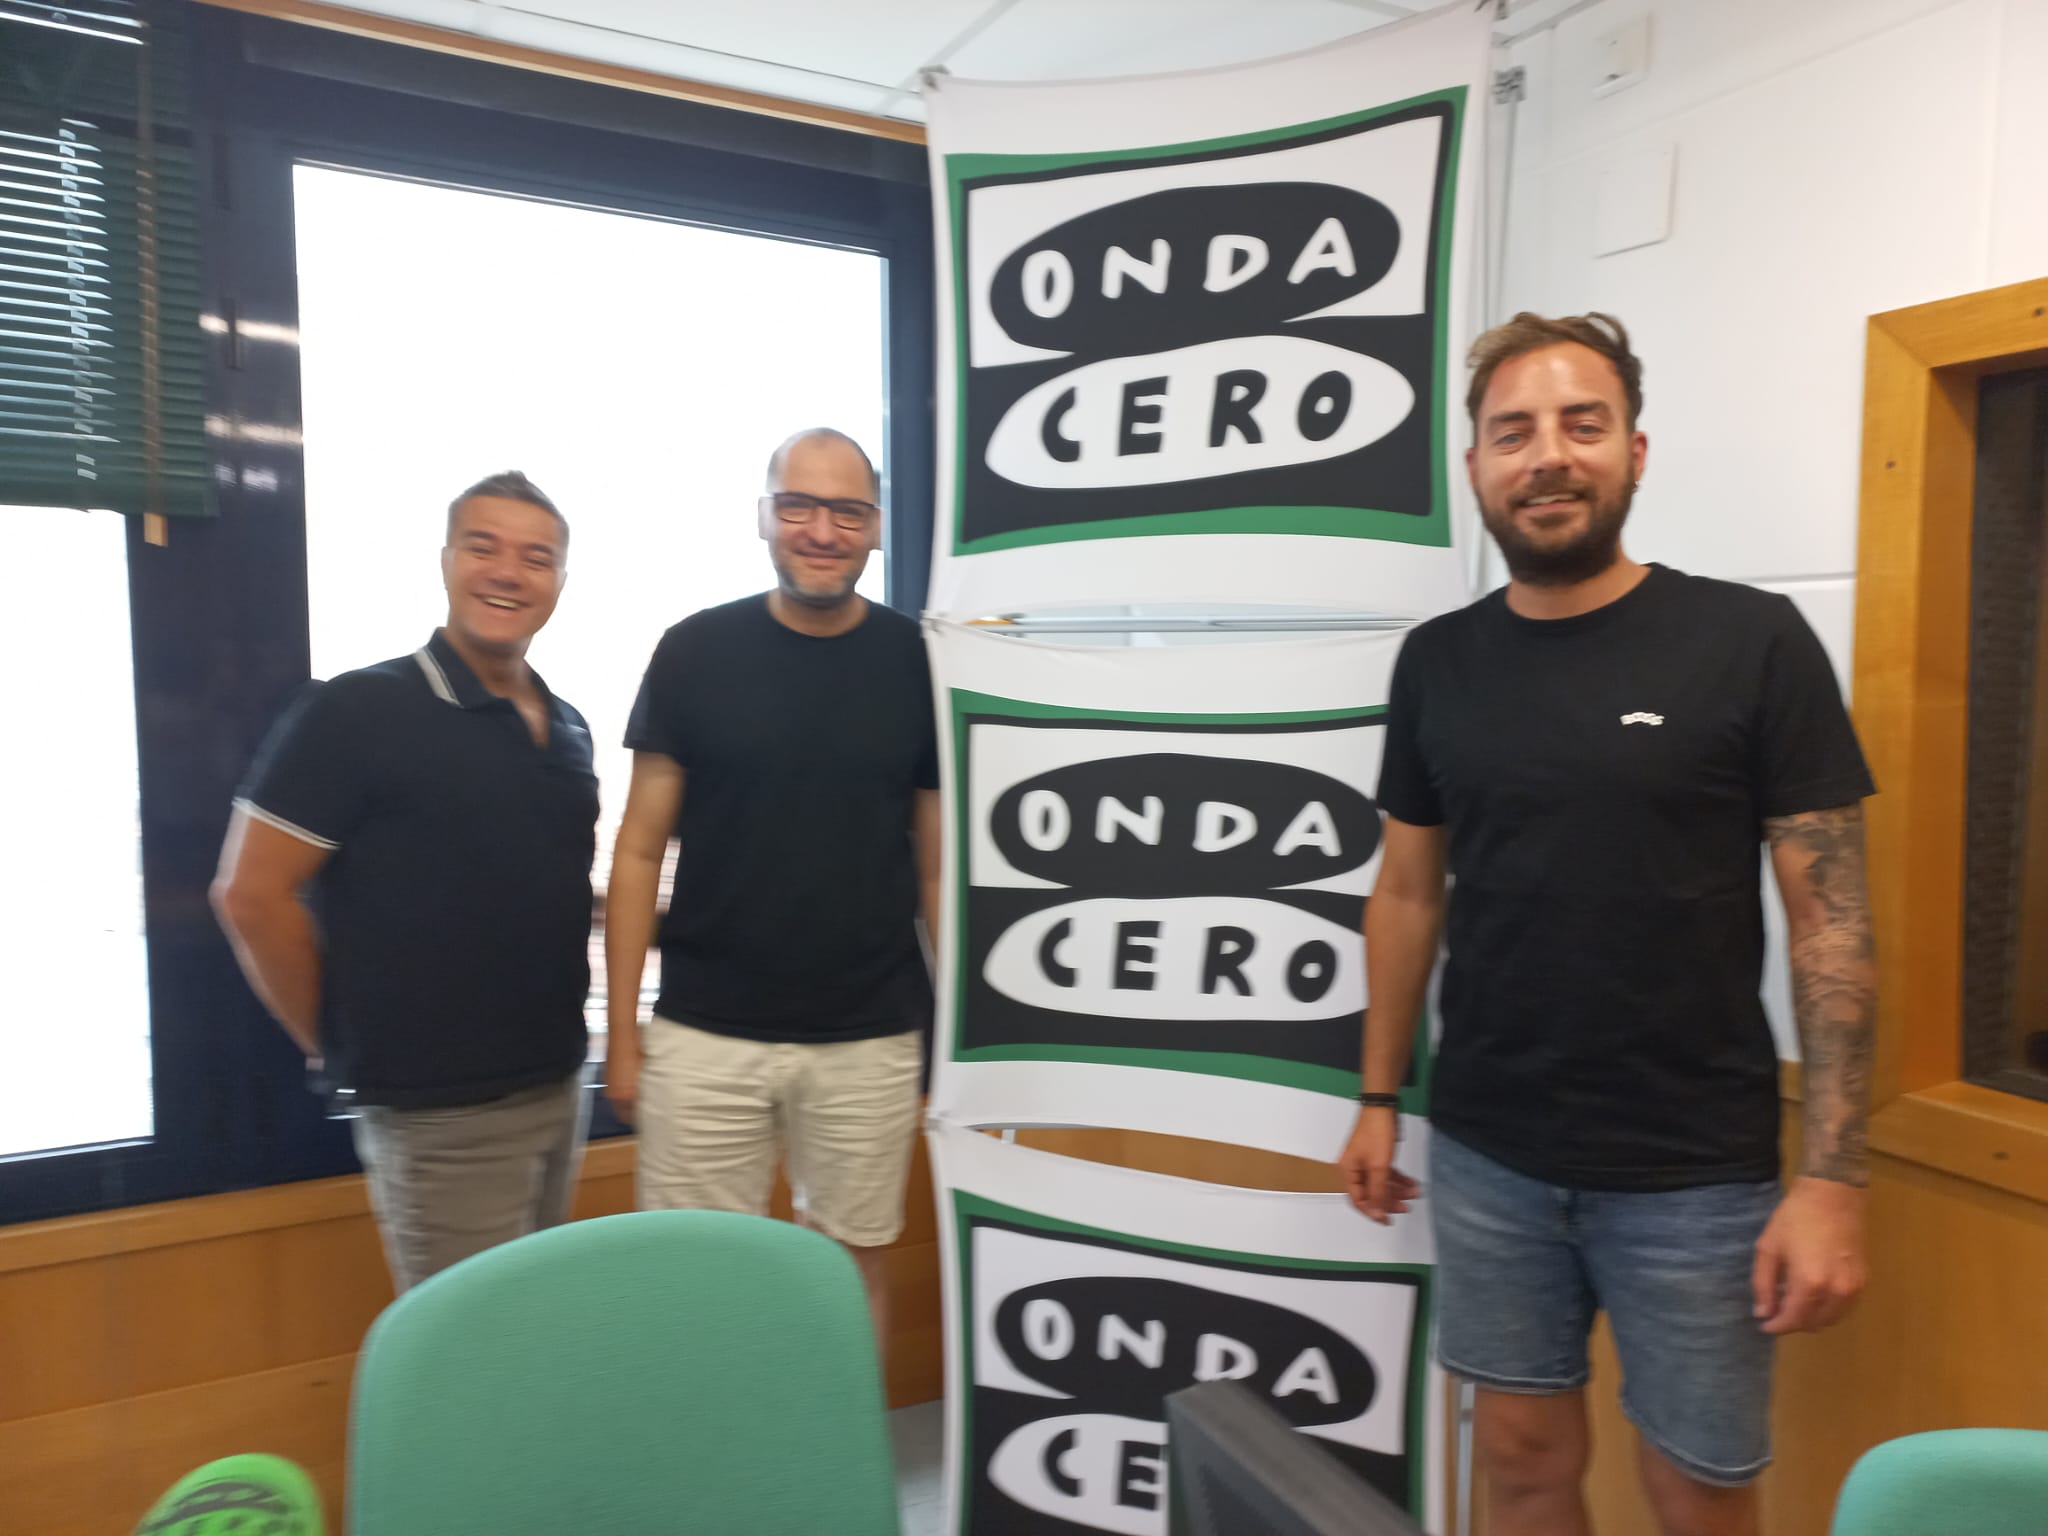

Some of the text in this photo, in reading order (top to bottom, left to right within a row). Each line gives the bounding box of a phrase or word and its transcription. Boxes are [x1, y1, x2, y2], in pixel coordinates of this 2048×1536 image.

[1020, 217, 1357, 319] ONDA
[1040, 369, 1353, 463] CERO
[1017, 789, 1343, 857] ONDA
[1038, 917, 1338, 1004] CERO
[1021, 1298, 1340, 1405] ONDA
[1042, 1427, 1168, 1512] CE
